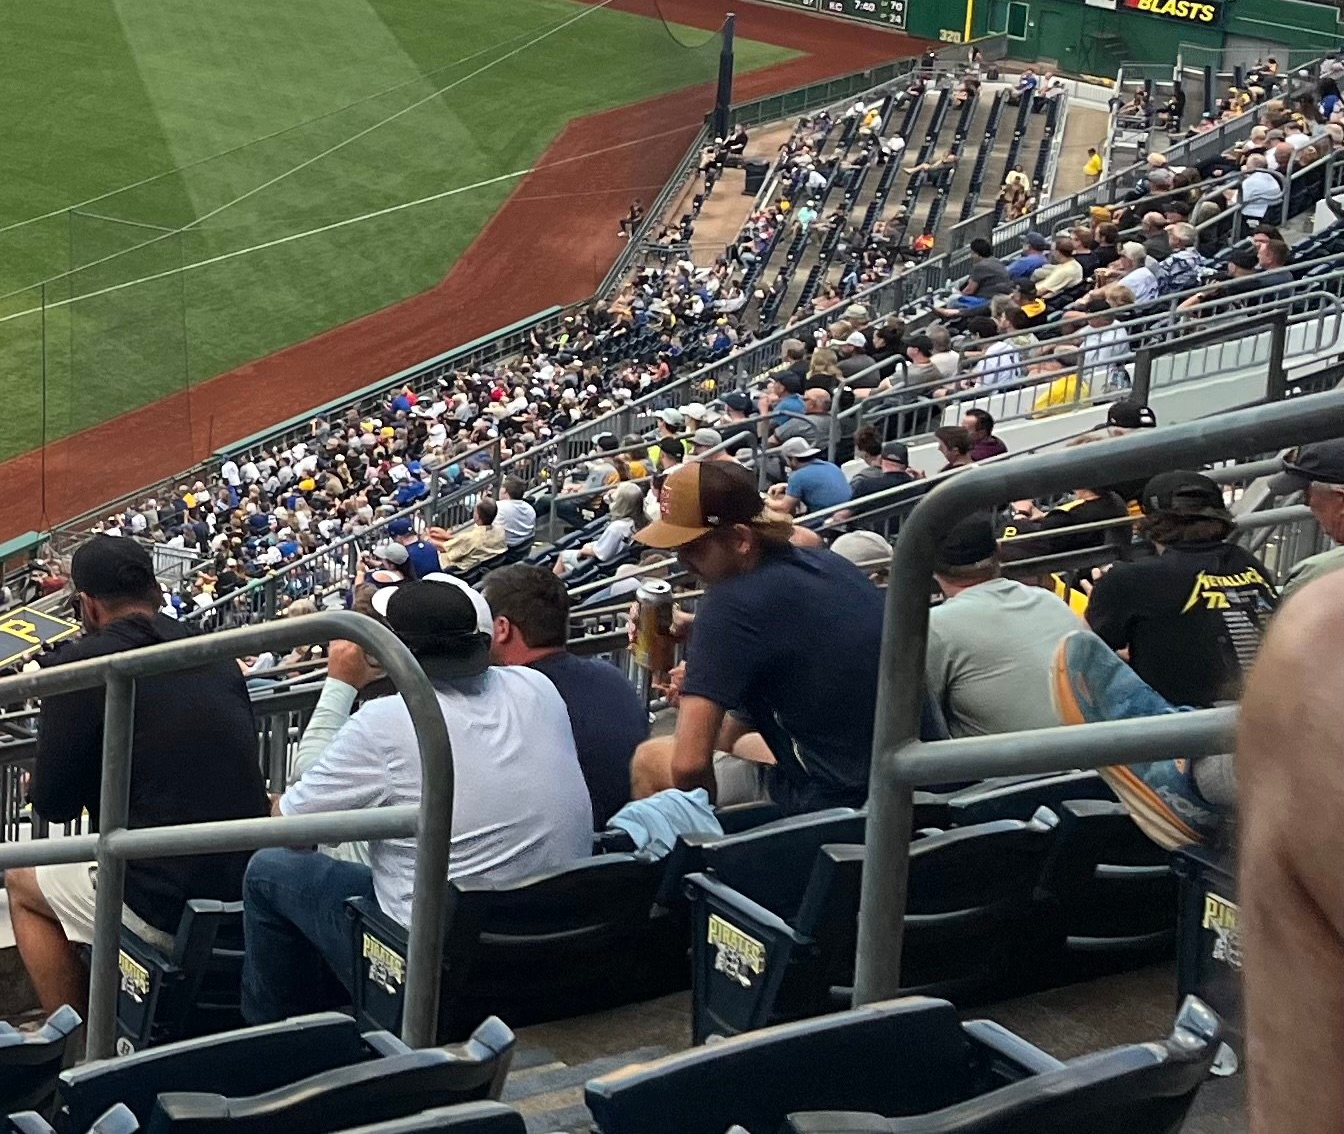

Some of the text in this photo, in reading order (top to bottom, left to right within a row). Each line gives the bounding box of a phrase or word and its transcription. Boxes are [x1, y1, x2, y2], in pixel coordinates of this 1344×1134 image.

[939, 28, 962, 43] 320
[1181, 566, 1279, 614] METALLICA
[1201, 591, 1231, 609] 72
[363, 932, 406, 985] PIRATES
[708, 913, 766, 974] PIRATES
